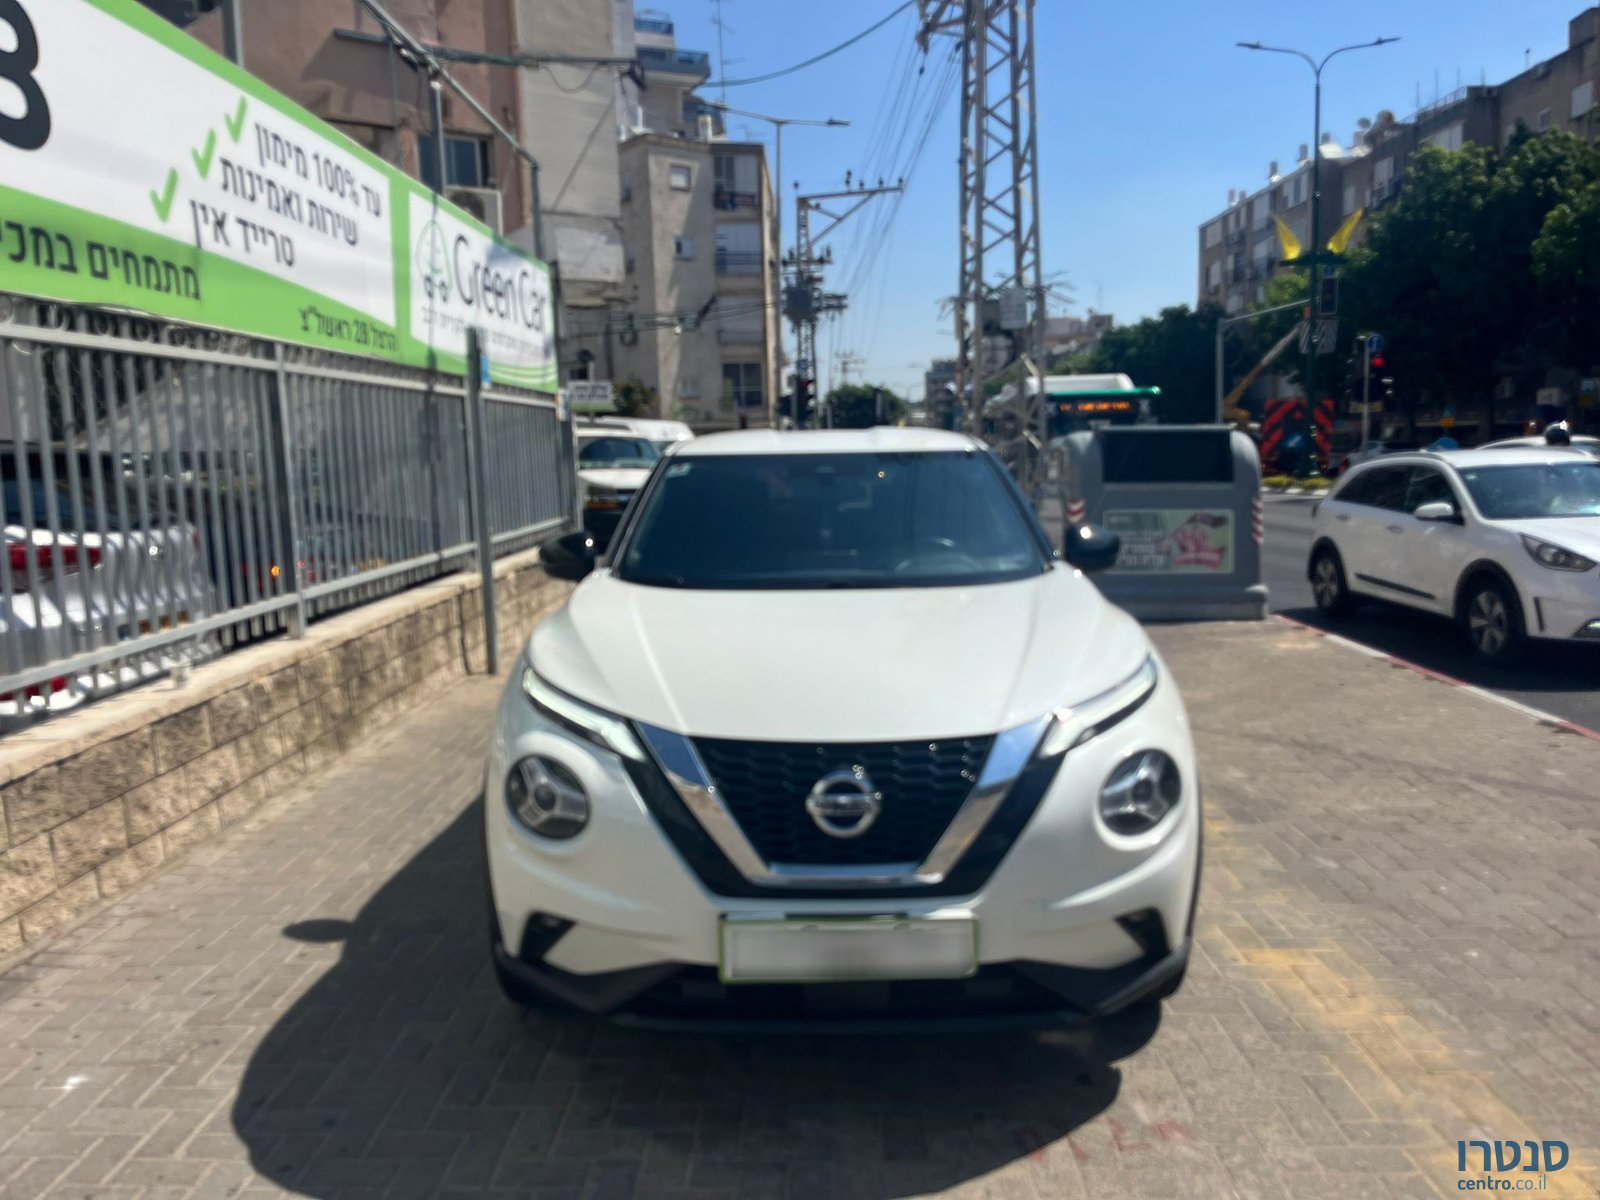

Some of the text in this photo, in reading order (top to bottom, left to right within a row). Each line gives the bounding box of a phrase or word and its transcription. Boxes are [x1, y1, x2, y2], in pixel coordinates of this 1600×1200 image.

[220, 157, 358, 246] שירות ואמינות
[255, 122, 381, 217] עד 100% מימון
[190, 199, 231, 249] אין
[86, 240, 201, 301] מתמחים
